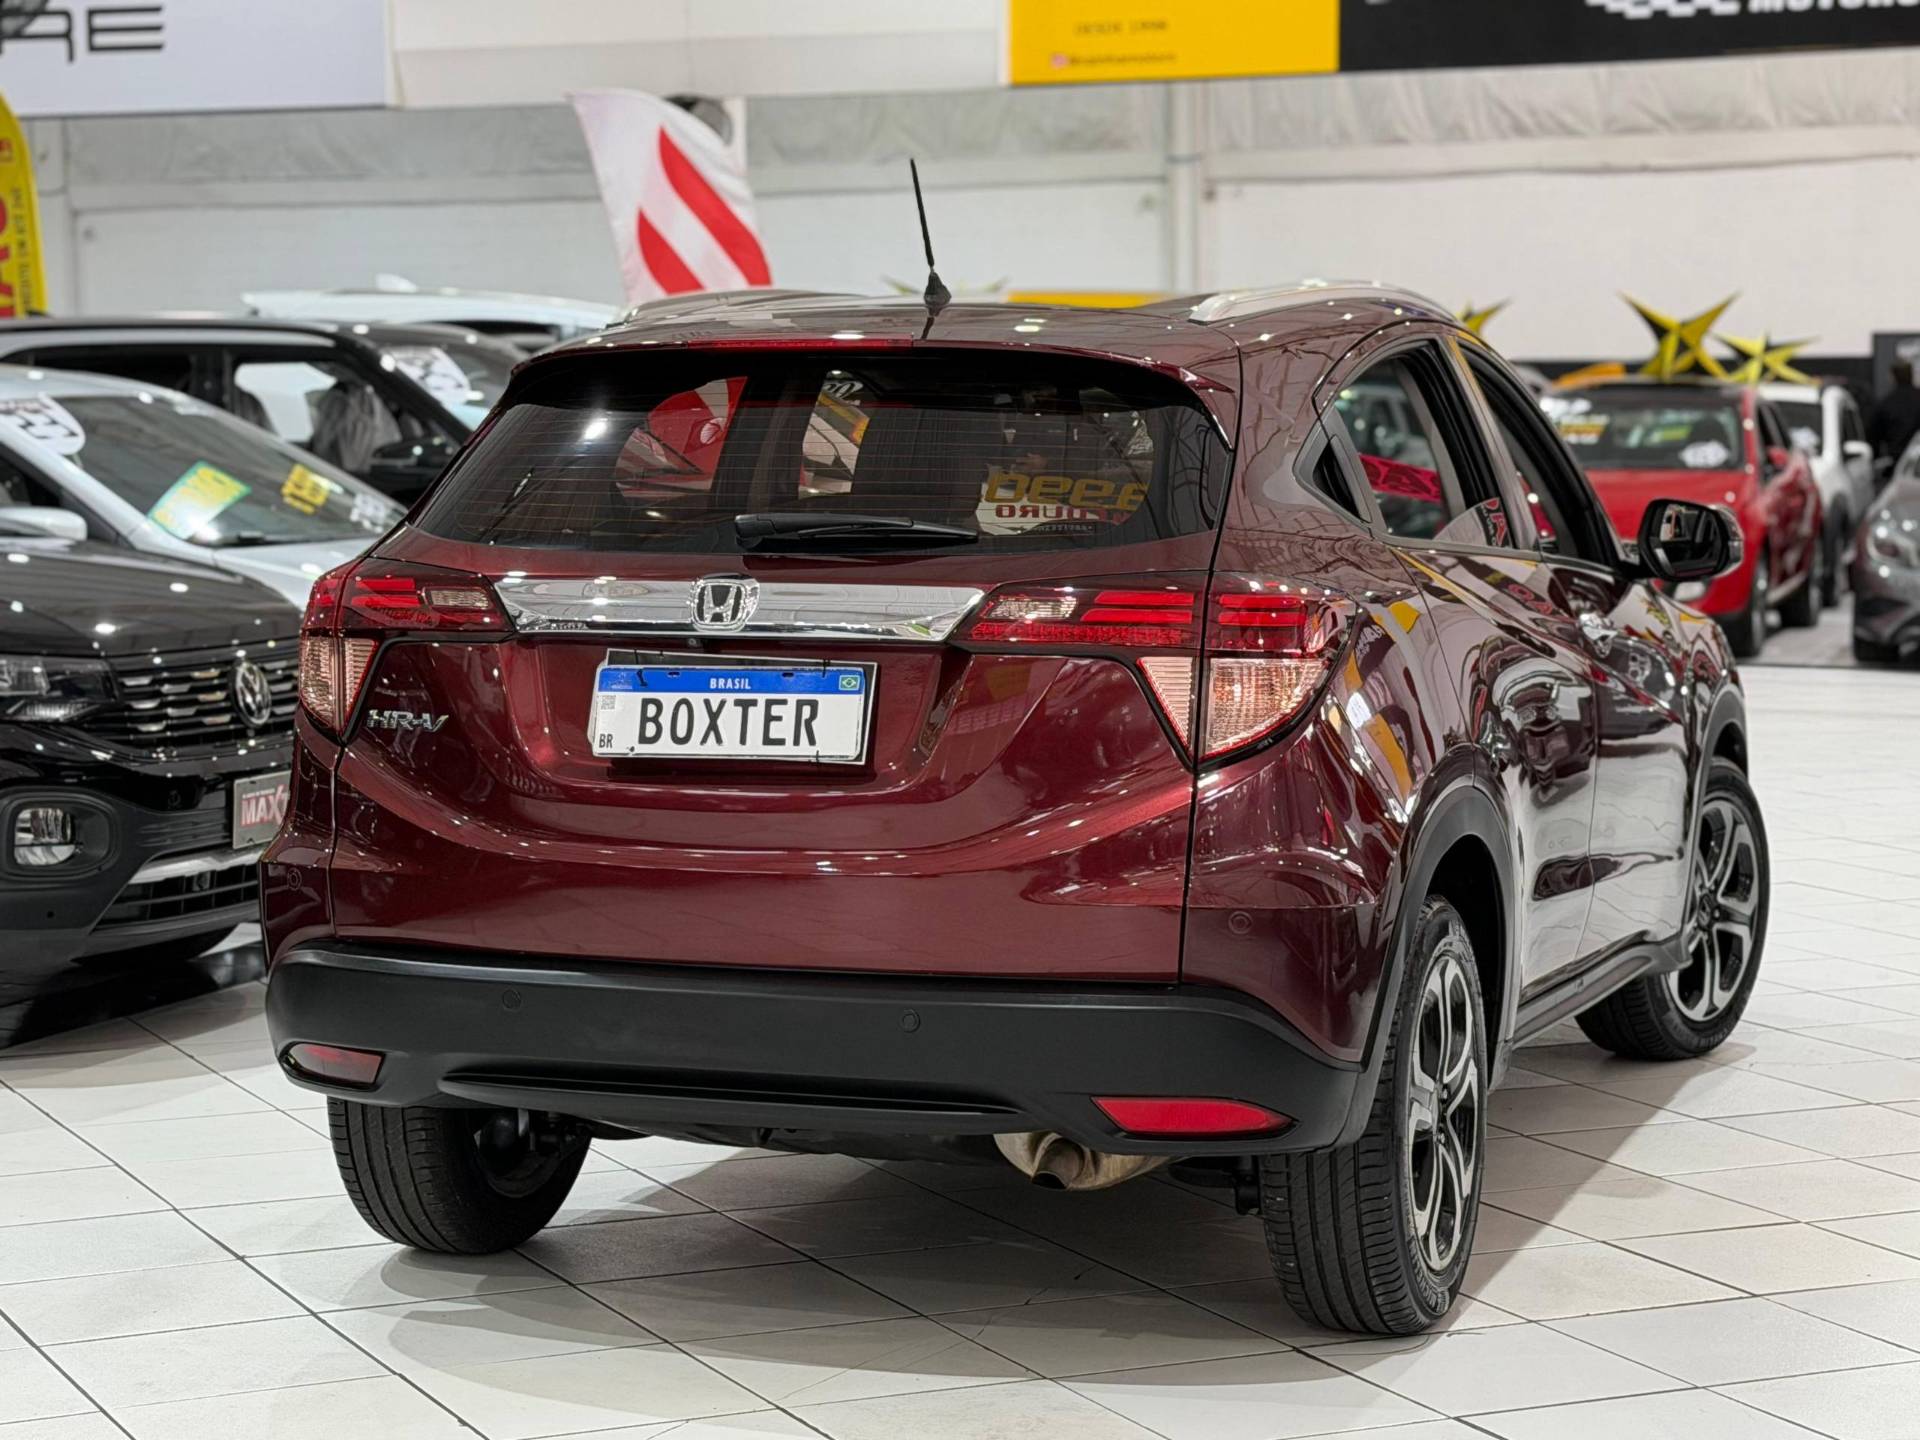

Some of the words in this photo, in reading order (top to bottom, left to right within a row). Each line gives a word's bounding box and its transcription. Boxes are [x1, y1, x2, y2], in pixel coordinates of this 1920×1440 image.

[709, 677, 752, 690] BRASIL
[366, 709, 449, 732] HR-V
[637, 697, 820, 747] BOXTER
[599, 733, 613, 749] BR
